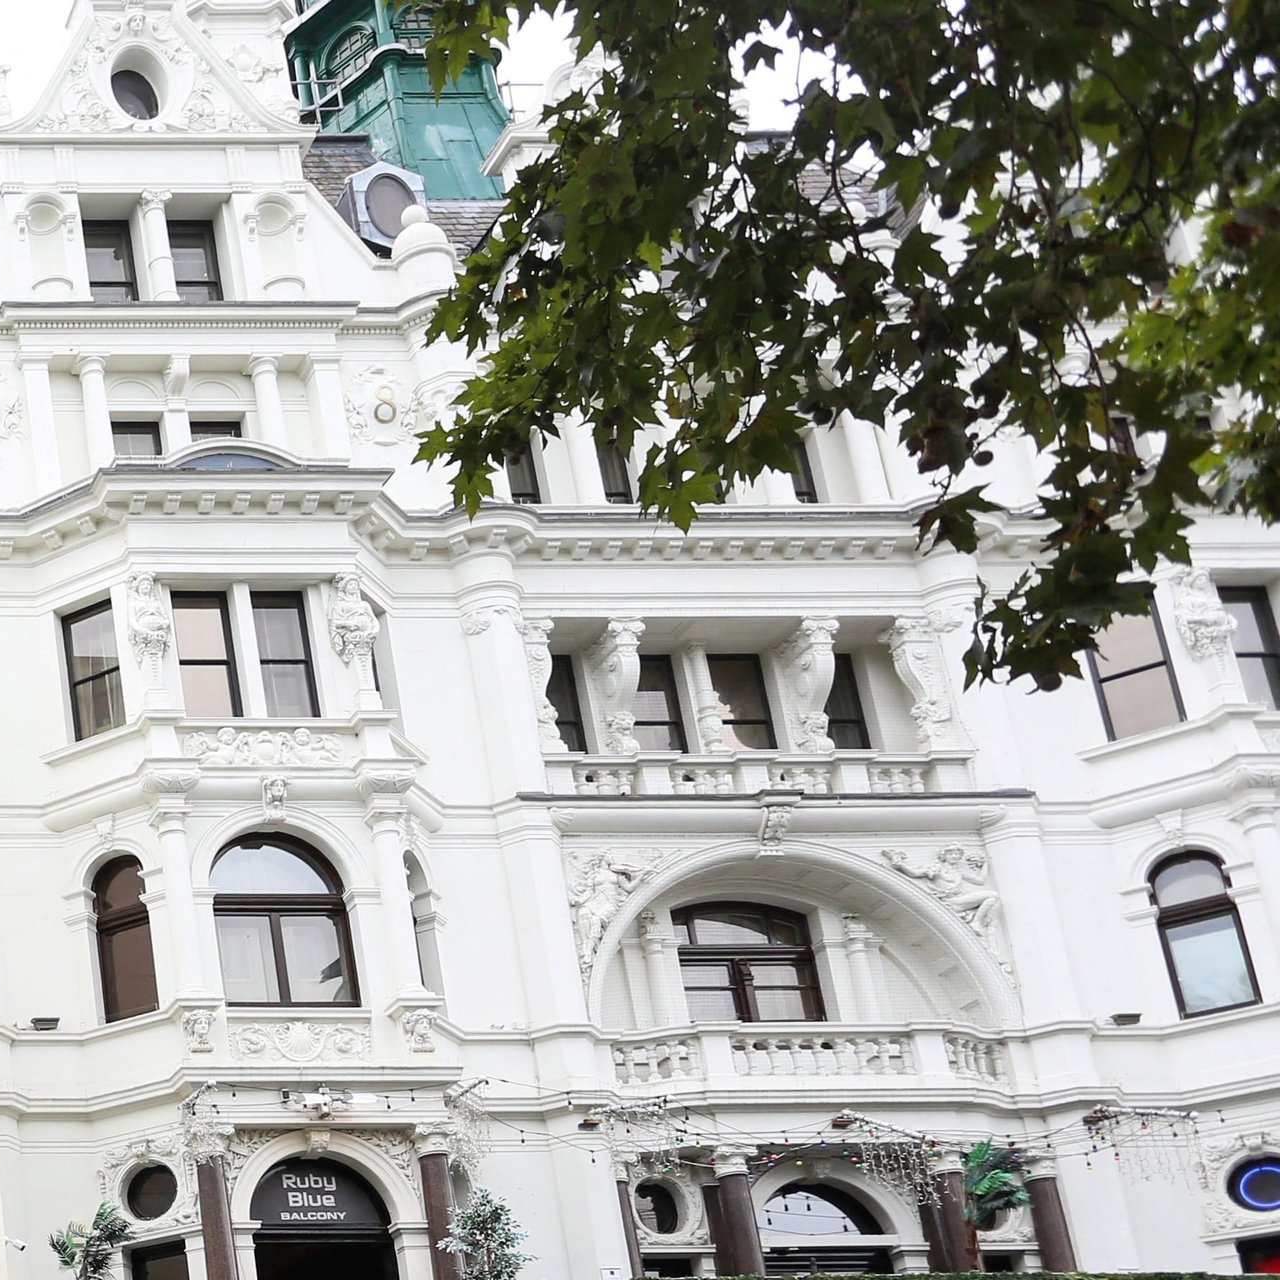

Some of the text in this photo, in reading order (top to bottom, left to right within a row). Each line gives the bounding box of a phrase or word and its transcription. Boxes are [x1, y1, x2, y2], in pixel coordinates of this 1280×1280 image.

[373, 384, 397, 424] 8
[282, 1173, 337, 1191] Ruby
[287, 1191, 336, 1207] Blue
[280, 1211, 347, 1221] BALCONY
